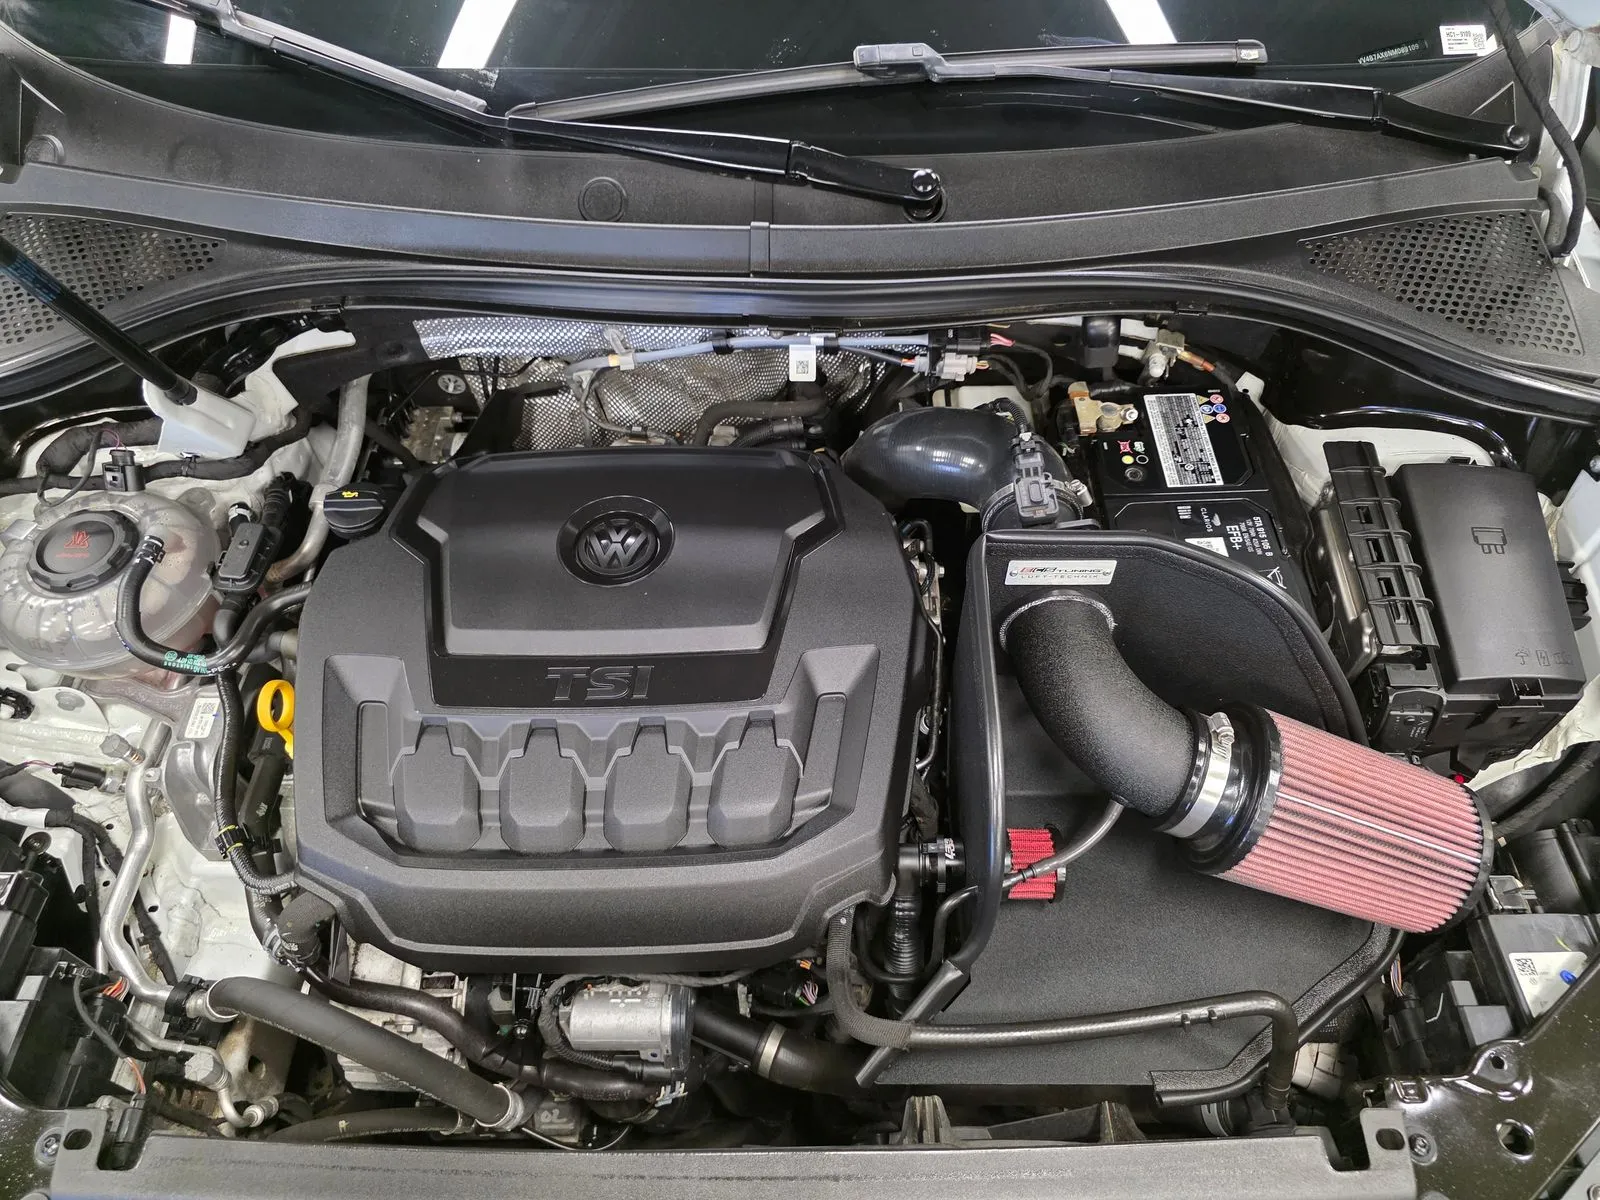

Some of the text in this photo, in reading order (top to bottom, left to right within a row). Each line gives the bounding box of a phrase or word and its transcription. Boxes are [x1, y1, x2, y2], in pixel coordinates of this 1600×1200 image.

[1200, 507, 1214, 533] CLARIOS
[1226, 525, 1243, 551] EFB+
[545, 665, 655, 700] TSI
